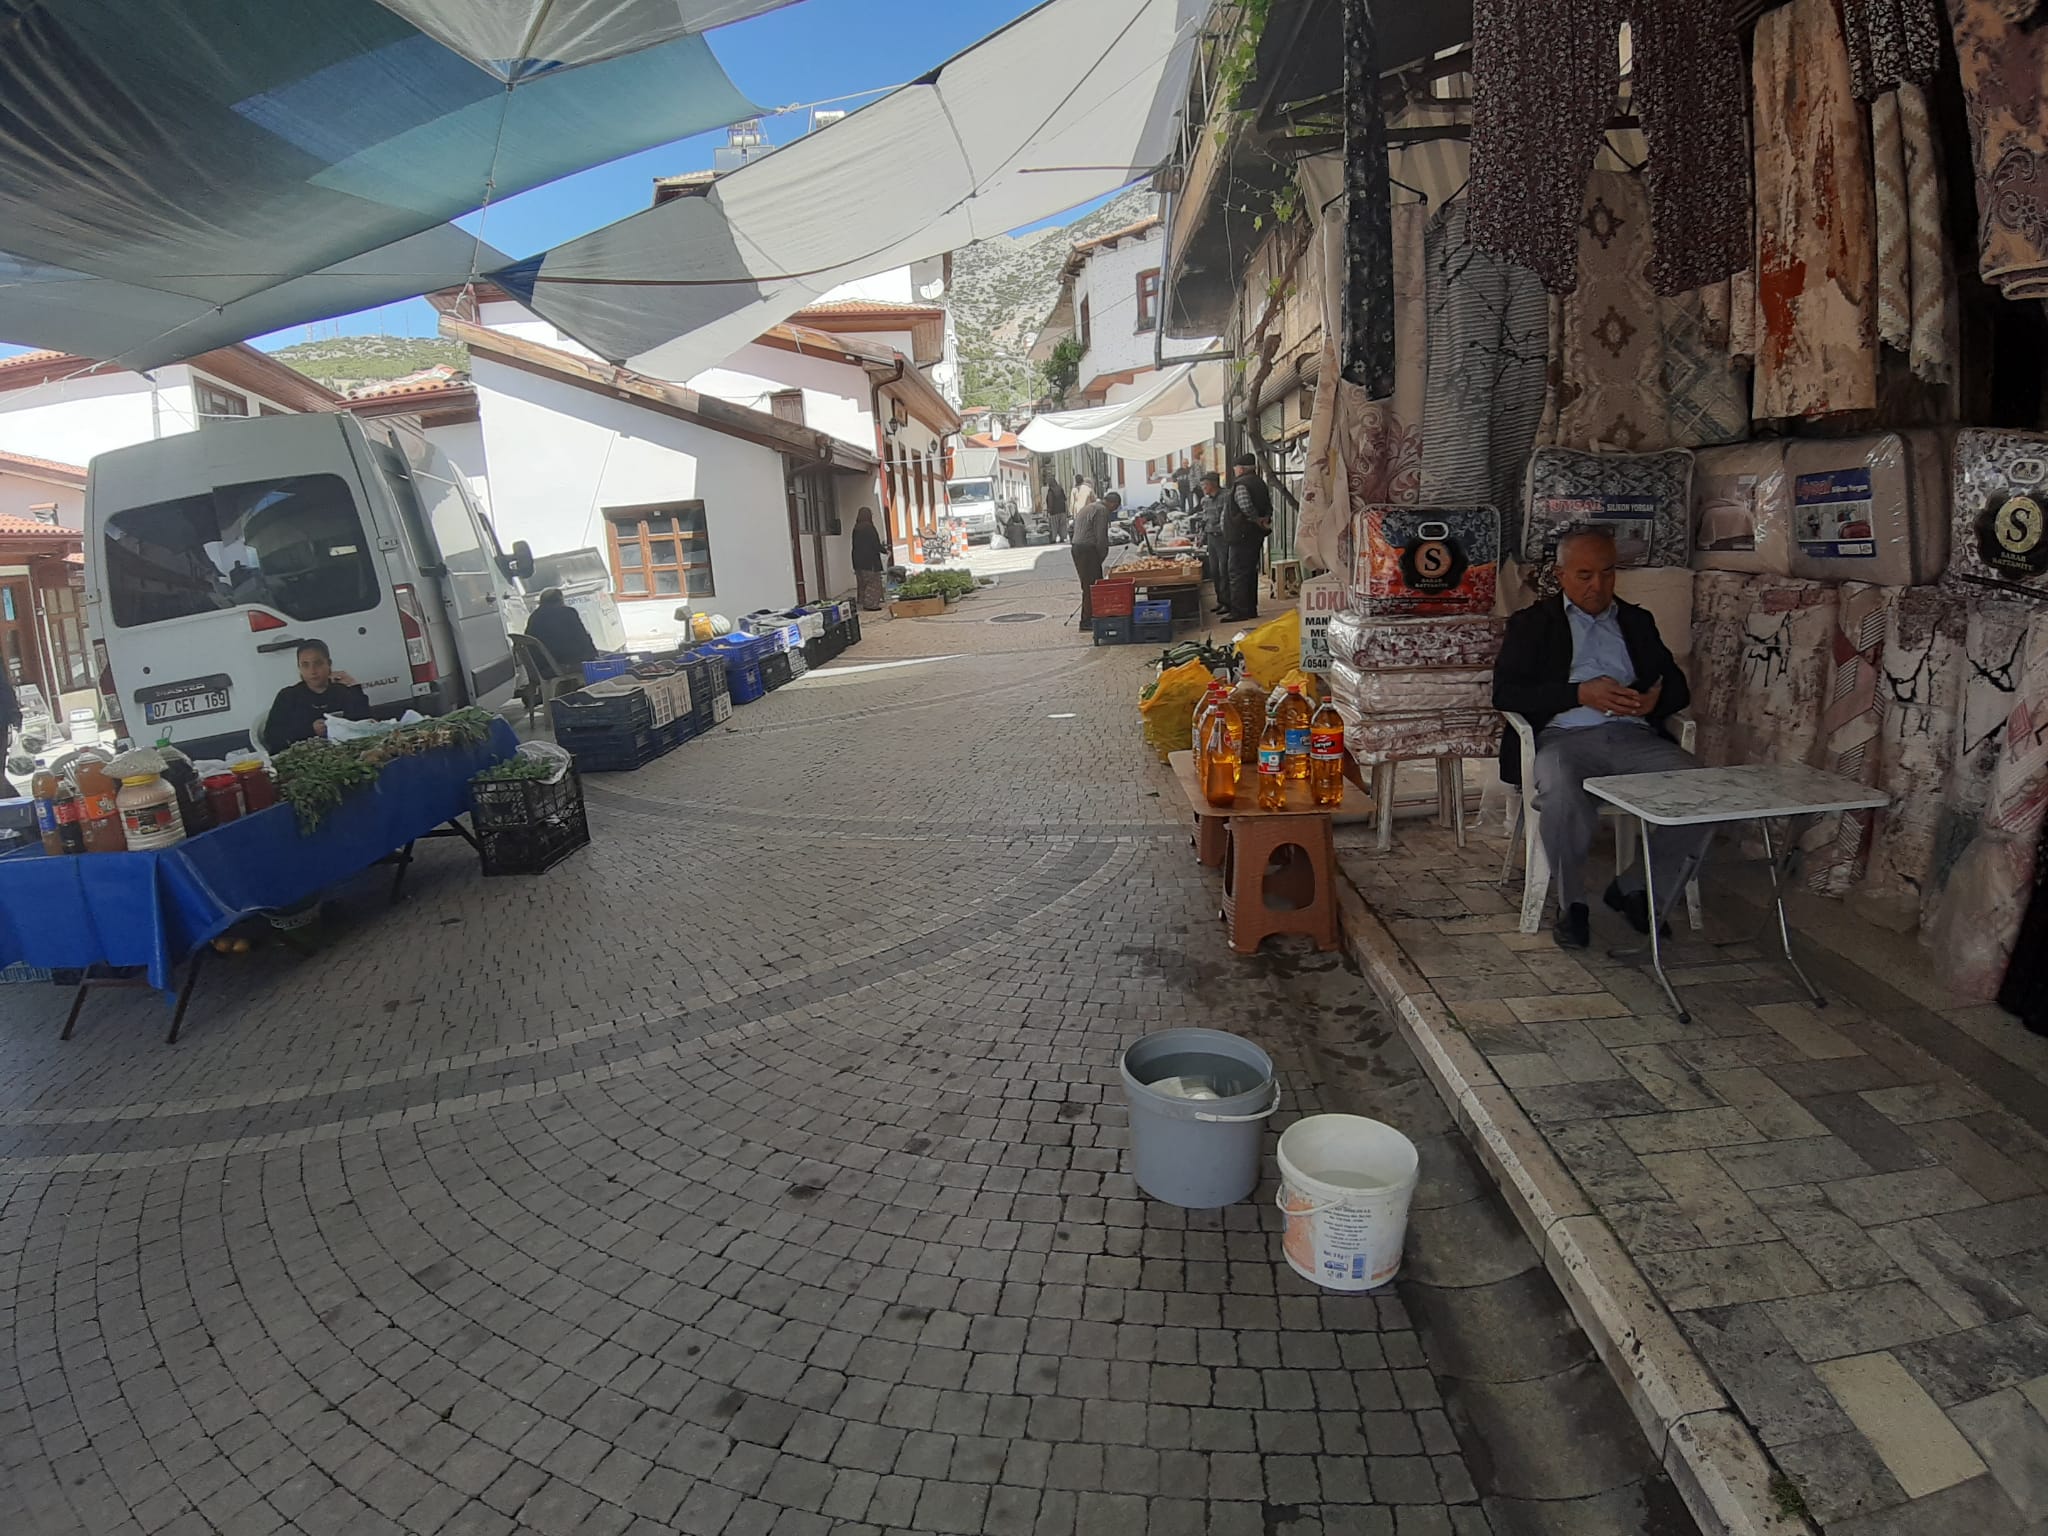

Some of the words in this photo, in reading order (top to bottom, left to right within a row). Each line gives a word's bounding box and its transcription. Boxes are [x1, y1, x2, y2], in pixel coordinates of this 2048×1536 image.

[2006, 507, 2031, 543] S
[1424, 548, 1441, 571] S
[1305, 615, 1331, 626] MAN
[1310, 628, 1328, 638] ME
[1307, 659, 1328, 669] 0544
[153, 702, 168, 718] 07
[174, 697, 196, 714] CEY
[204, 692, 226, 708] 169
